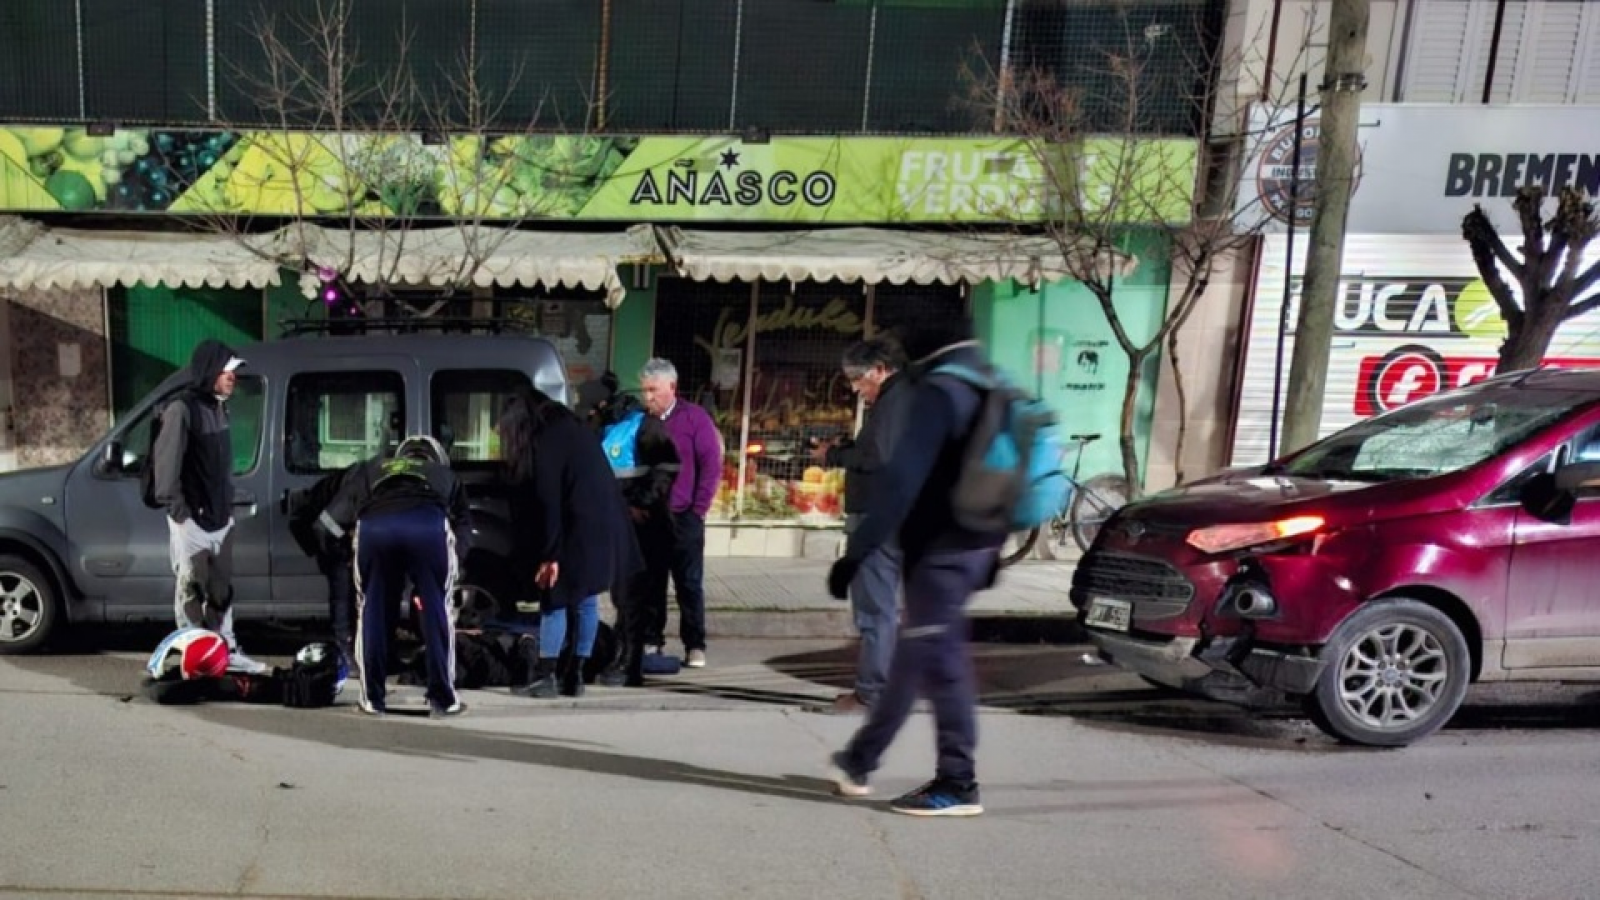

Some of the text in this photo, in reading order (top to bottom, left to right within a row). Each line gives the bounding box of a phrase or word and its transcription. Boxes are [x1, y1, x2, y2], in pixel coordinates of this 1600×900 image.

[630, 160, 837, 206] AÑASCO
[901, 150, 1056, 183] FRUTA
[1286, 281, 1451, 332] UCA
